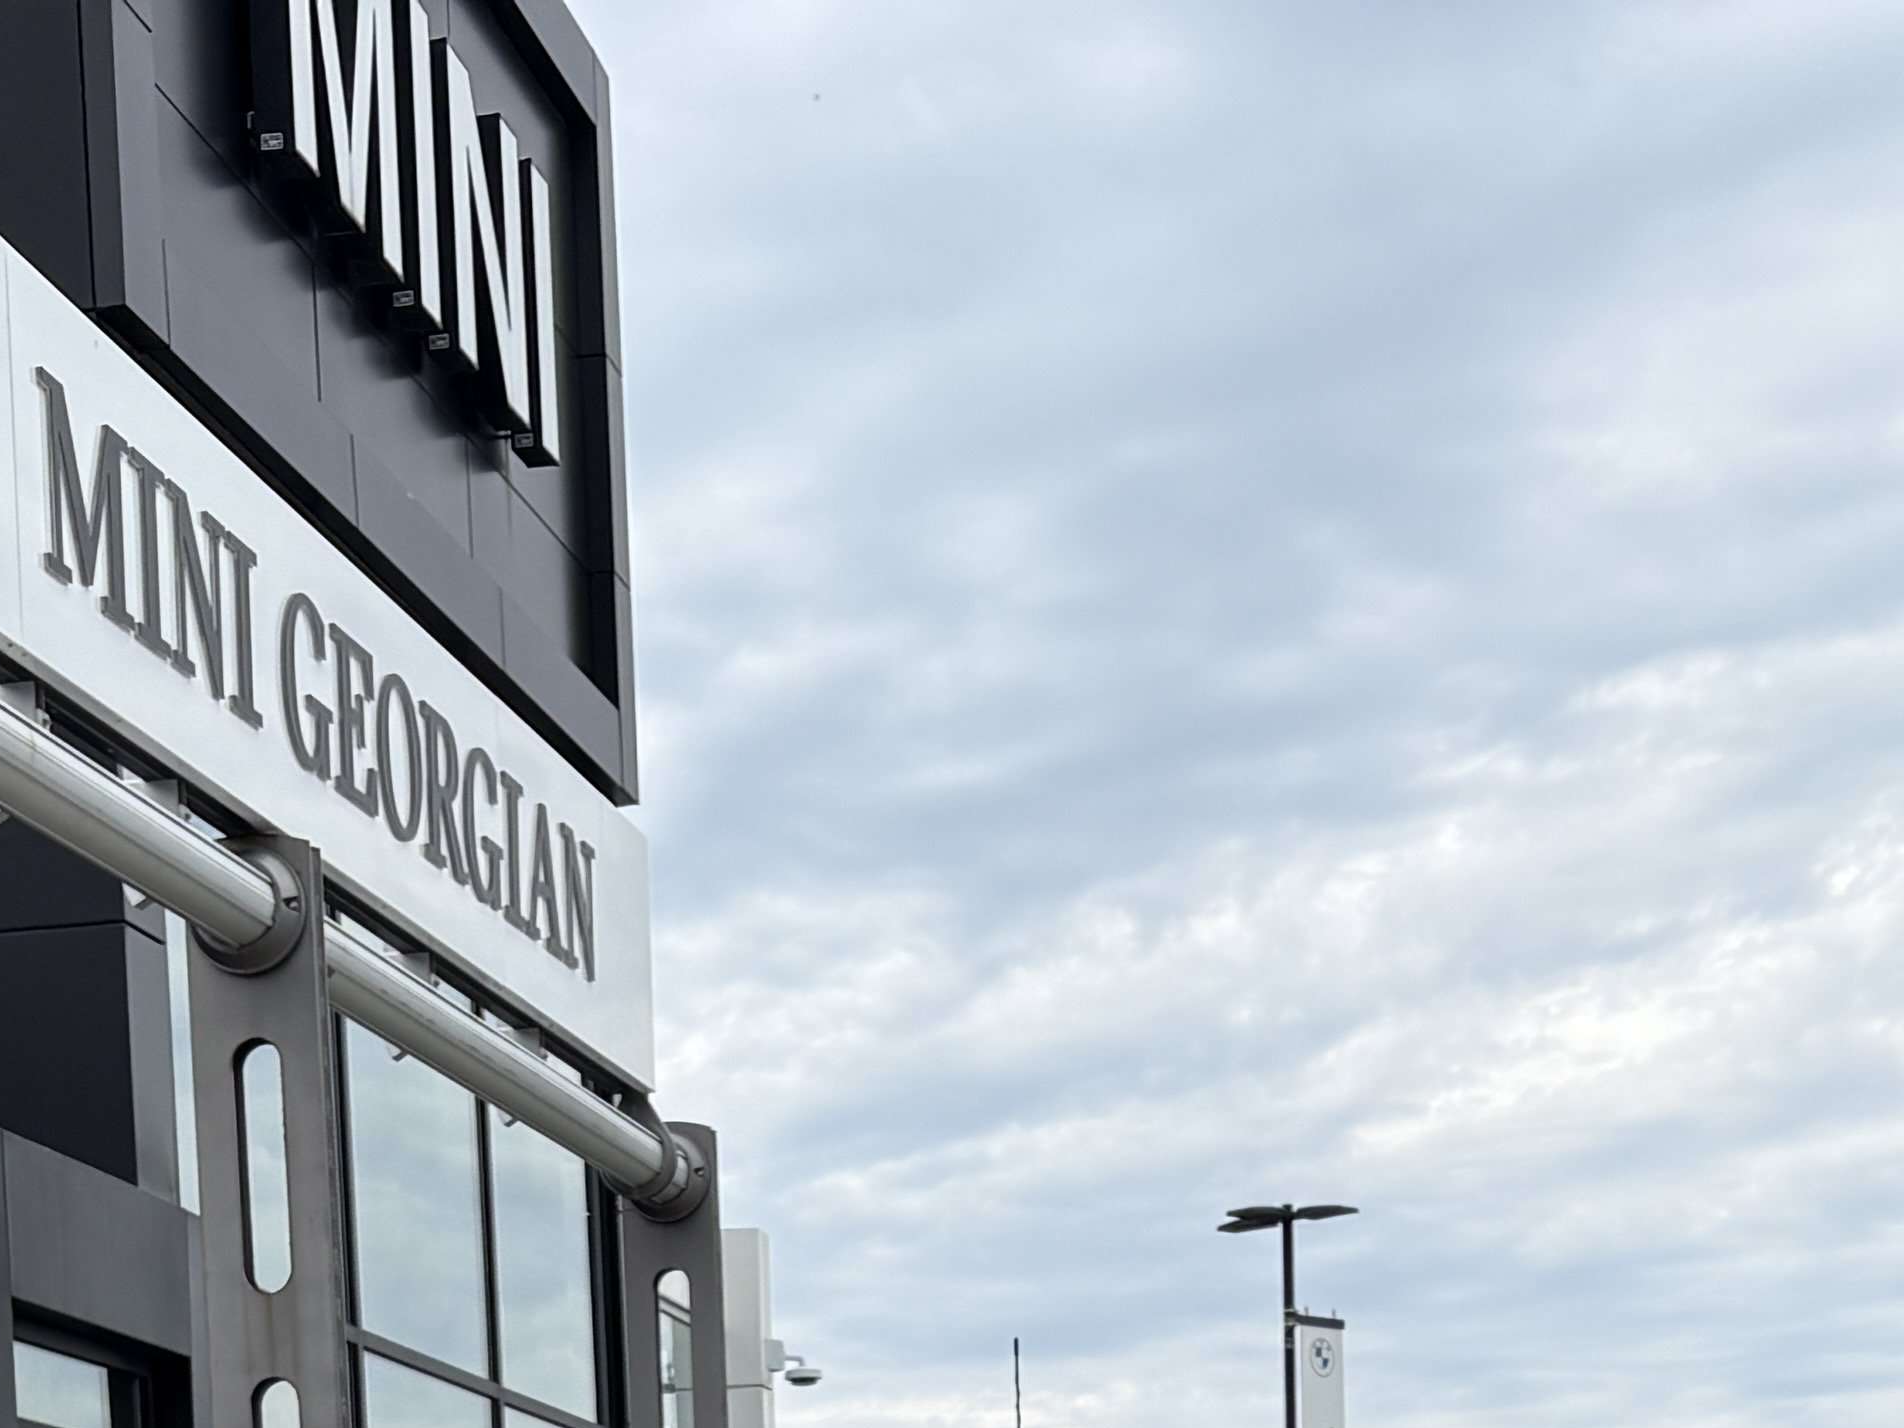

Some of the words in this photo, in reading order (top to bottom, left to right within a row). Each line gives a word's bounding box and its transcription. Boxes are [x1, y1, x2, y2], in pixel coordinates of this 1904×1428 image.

[289, 0, 559, 466] MINI
[32, 366, 263, 729] MINI
[280, 594, 597, 981] GEORGIAN
